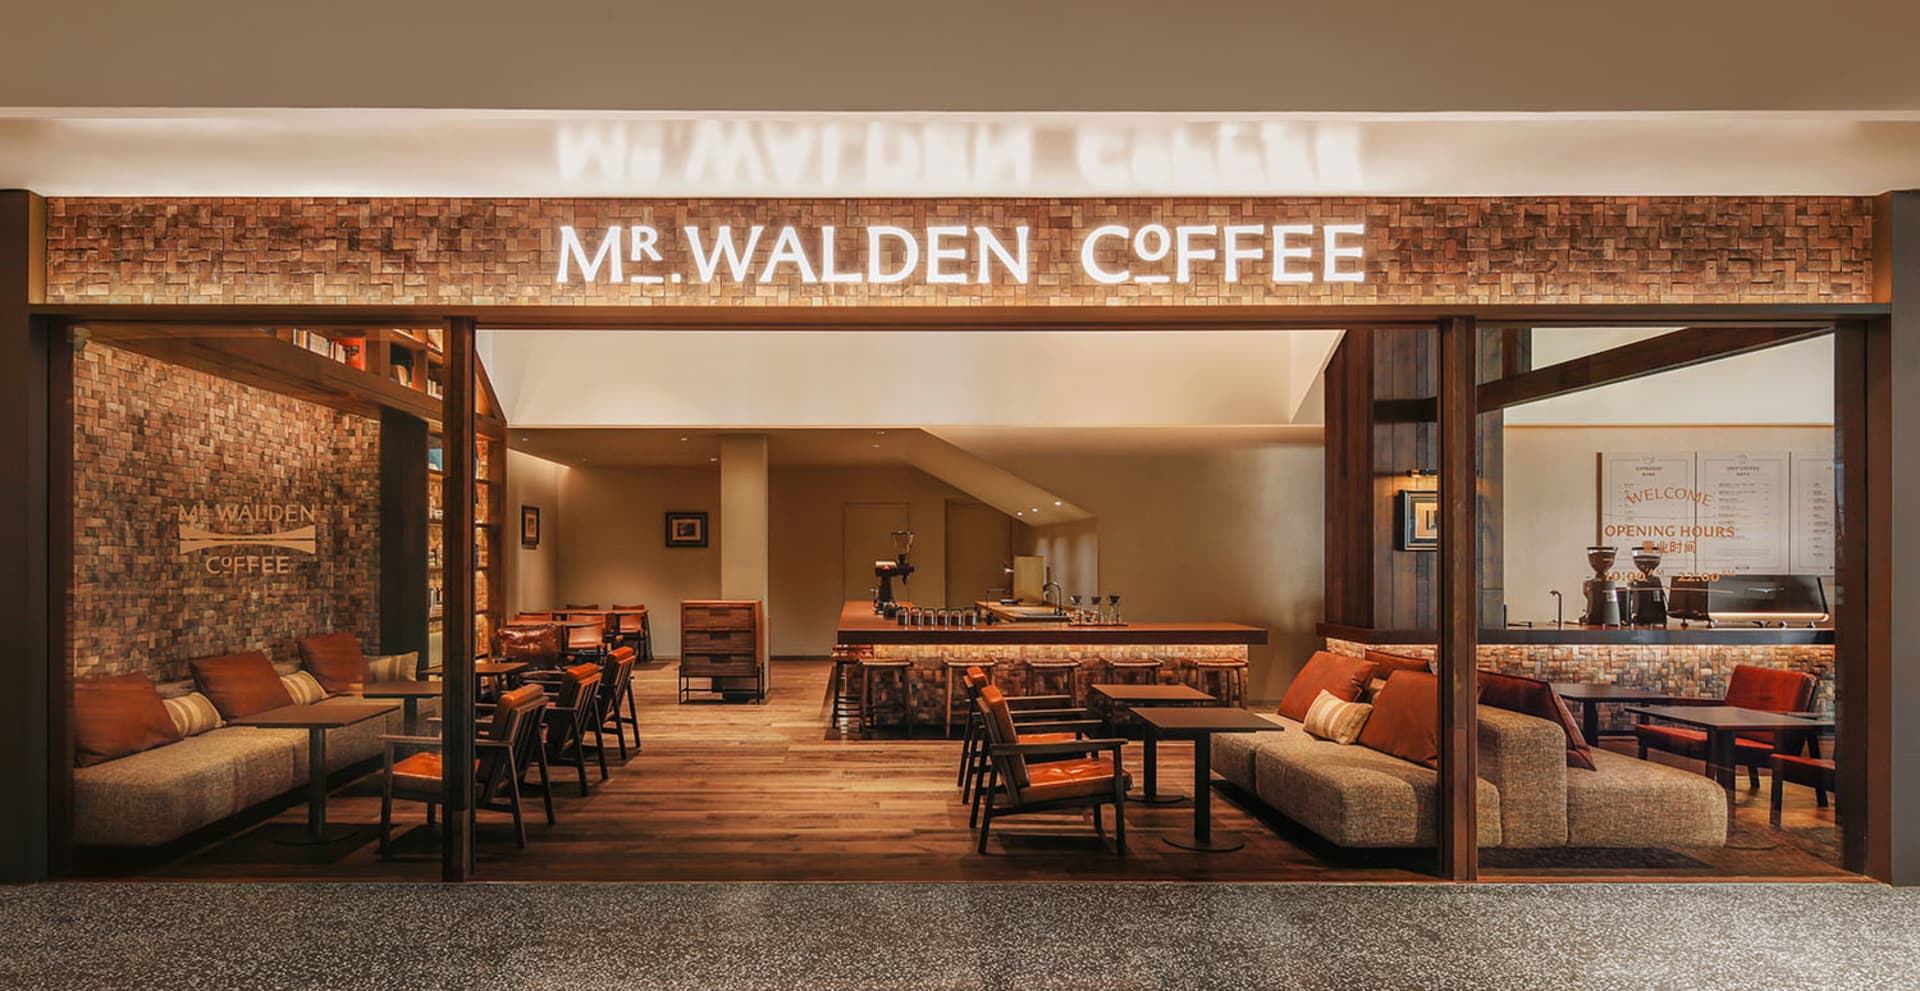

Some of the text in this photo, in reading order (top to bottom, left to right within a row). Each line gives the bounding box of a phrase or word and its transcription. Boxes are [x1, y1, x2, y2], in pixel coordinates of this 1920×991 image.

[684, 225, 1030, 284] WALDEN
[1626, 486, 1713, 507] WELCOME
[214, 503, 316, 523] WALDEN
[1604, 525, 1736, 538] OPENING HOURS
[1642, 540, 1697, 554] 营业时间
